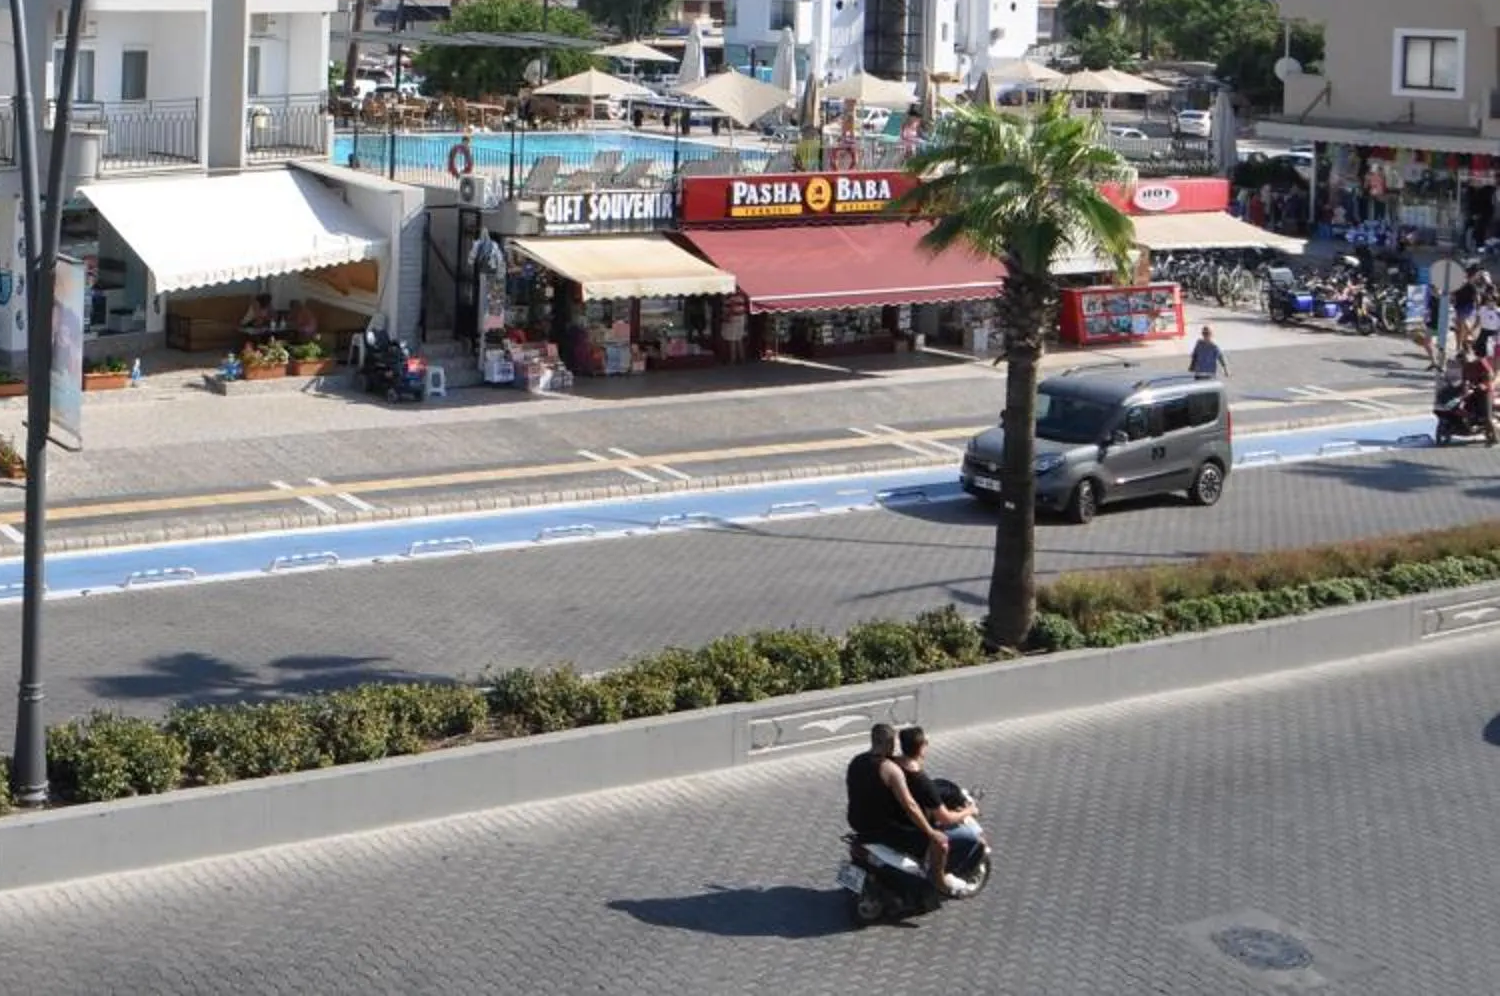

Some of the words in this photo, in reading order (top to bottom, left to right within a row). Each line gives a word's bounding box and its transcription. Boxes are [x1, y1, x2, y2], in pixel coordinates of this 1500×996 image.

[732, 181, 803, 205] PASHA
[836, 178, 891, 200] BABA
[544, 194, 585, 223] GIFT
[589, 192, 673, 221] SOUVENIR
